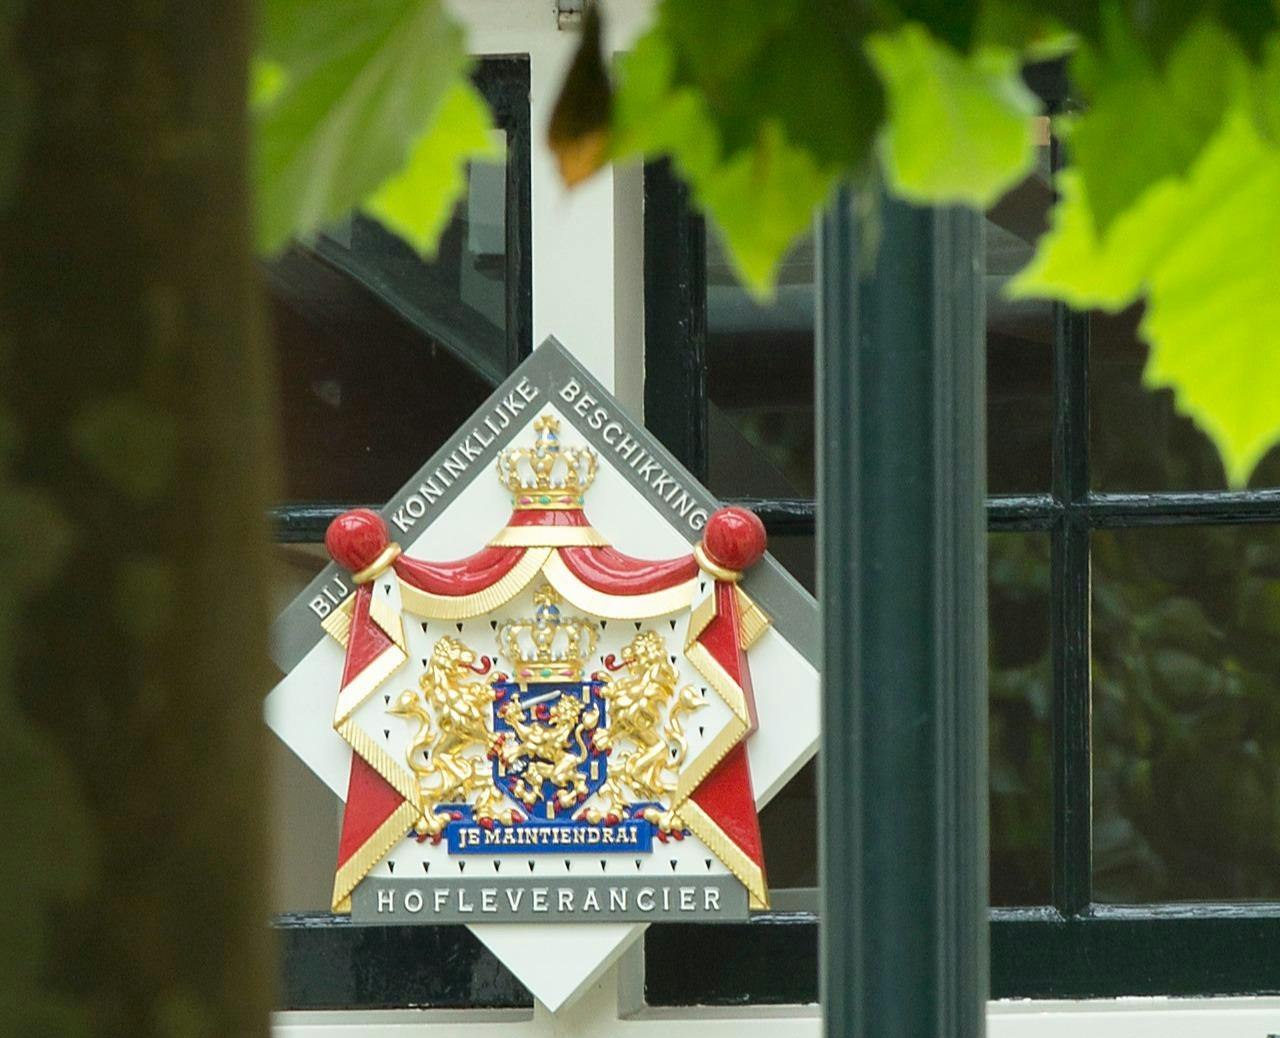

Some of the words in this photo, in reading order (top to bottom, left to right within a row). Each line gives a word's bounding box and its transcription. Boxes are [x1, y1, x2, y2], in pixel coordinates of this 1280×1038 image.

[308, 573, 349, 619] BIJ
[392, 376, 539, 533] KONINKLIJKE
[559, 377, 709, 531] BESCHIKKING
[458, 828, 480, 848] JE
[484, 826, 639, 845] MAINTIENDRAI
[376, 886, 722, 914] HOFLEVERANCIER
